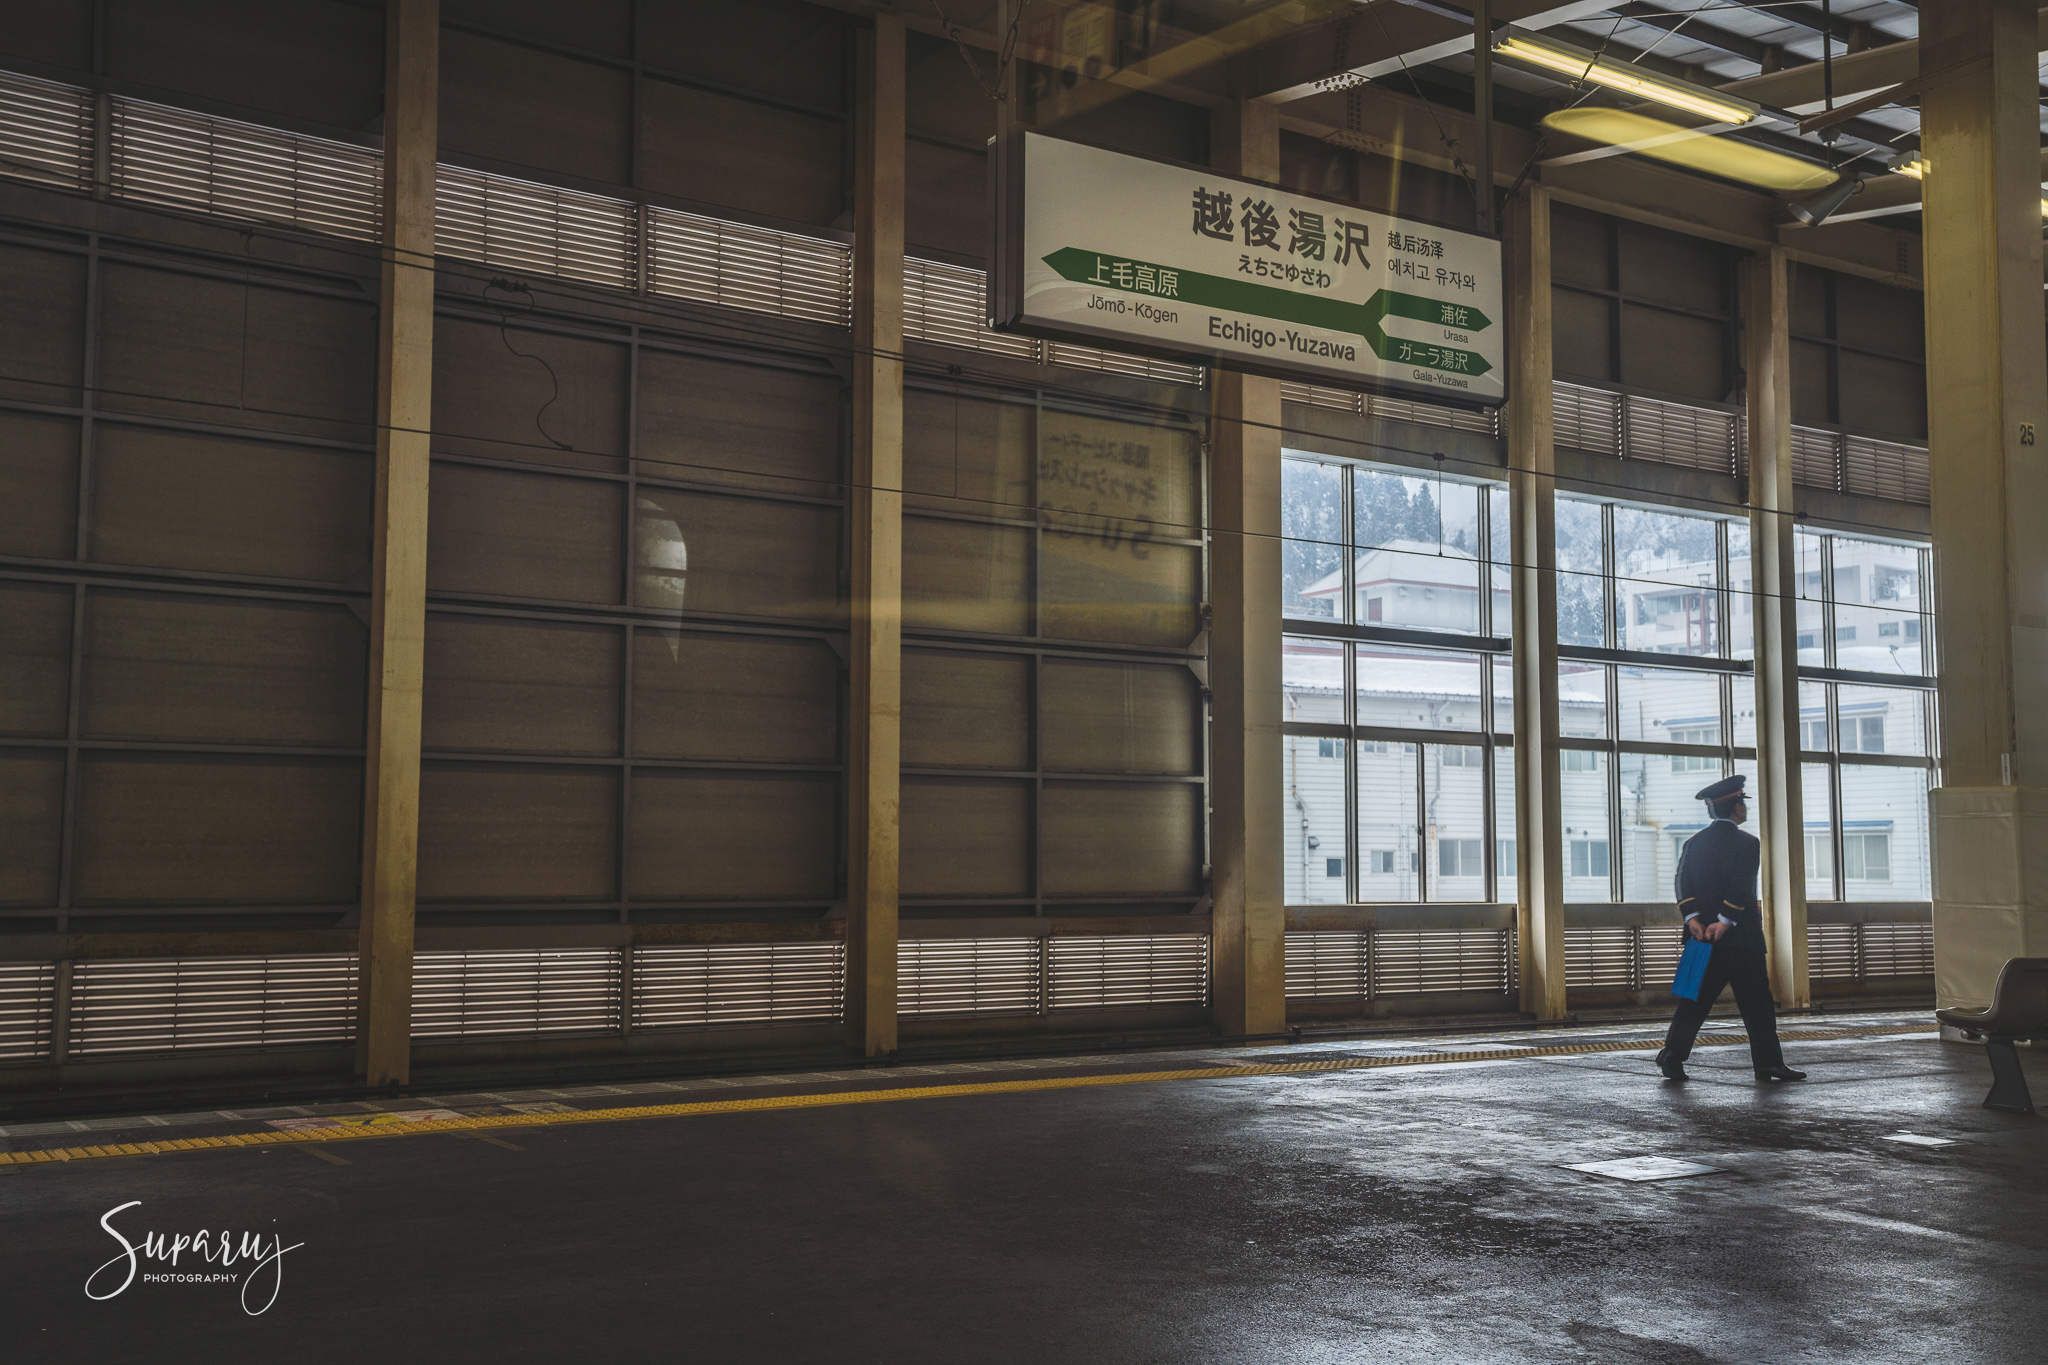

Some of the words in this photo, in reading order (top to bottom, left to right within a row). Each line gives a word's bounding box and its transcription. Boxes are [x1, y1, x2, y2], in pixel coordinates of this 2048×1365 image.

[1193, 186, 1371, 270] 越後湯沢
[1388, 230, 1444, 259] 越后汤泽
[1088, 256, 1179, 297] 上毛高原
[1238, 254, 1331, 288] えちごゆざわ
[1388, 258, 1430, 281] 에치고
[1435, 267, 1476, 292] 유자와
[1441, 304, 1468, 326] 浦佐
[1209, 316, 1355, 361] Echigo-Yuzawa
[1443, 329, 1469, 343] Urasa
[1399, 342, 1468, 371] ガーラ湯沢
[1412, 369, 1469, 389] Gala-Yuzawa
[2020, 424, 2035, 446] 25
